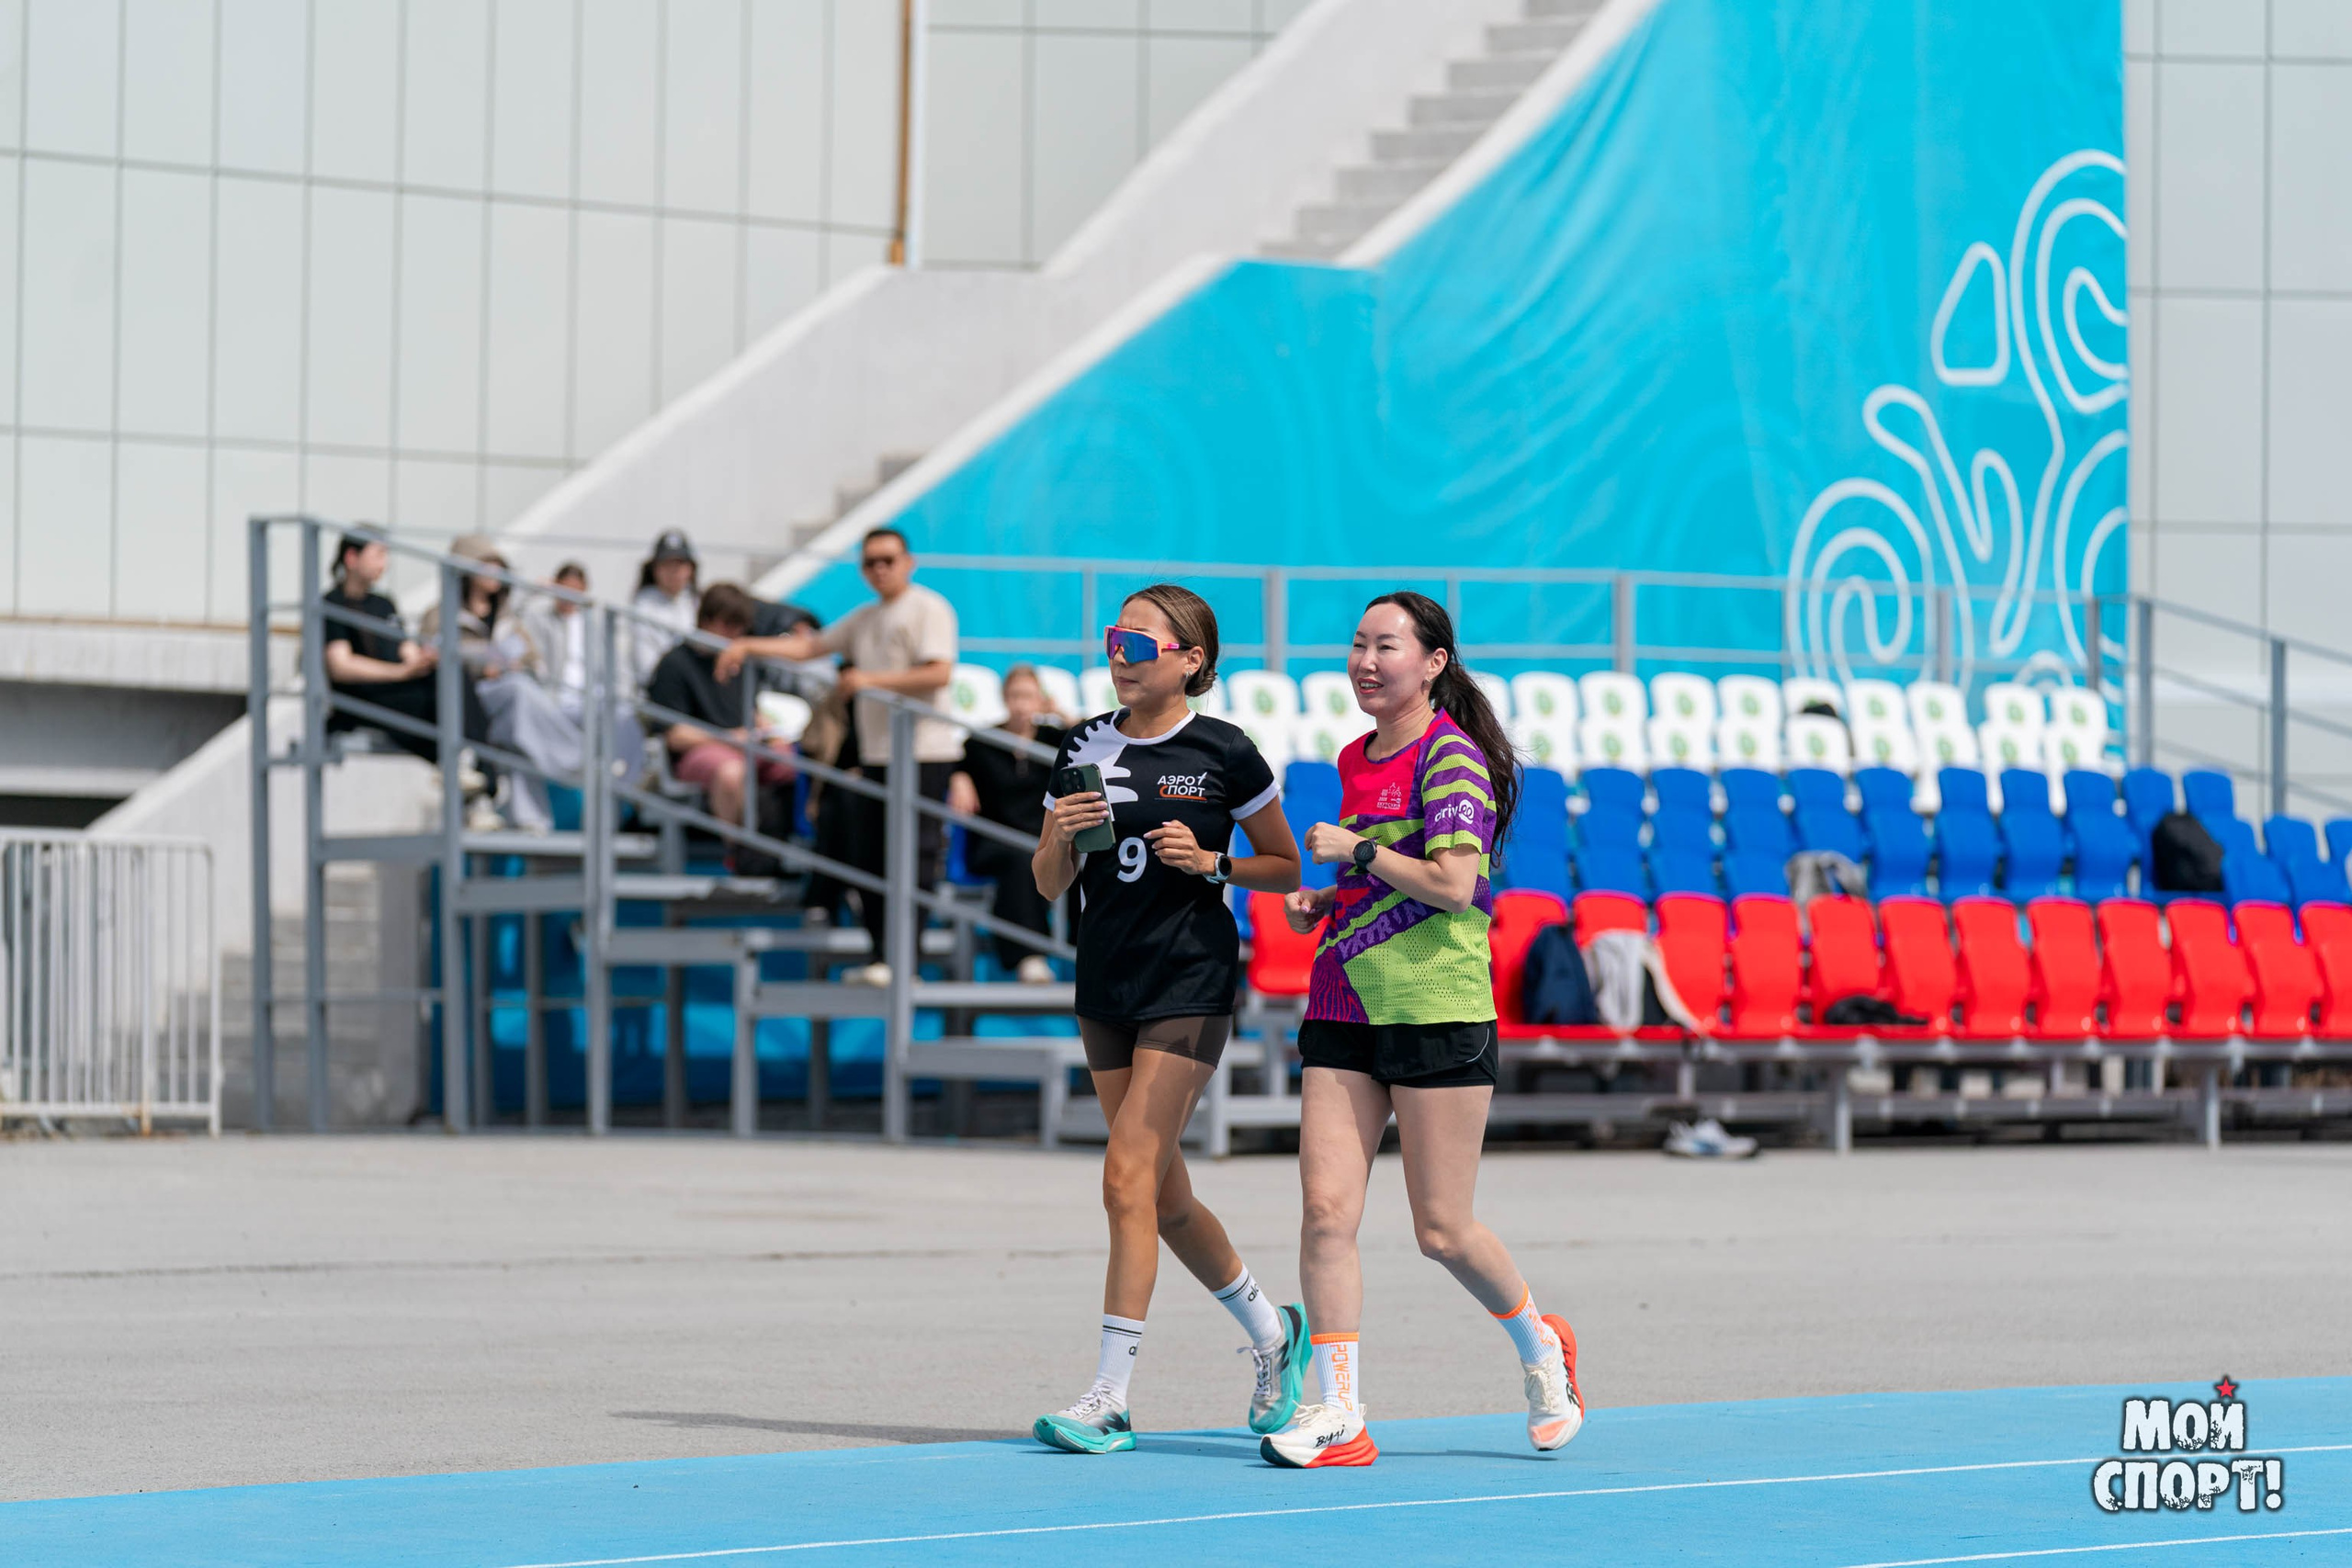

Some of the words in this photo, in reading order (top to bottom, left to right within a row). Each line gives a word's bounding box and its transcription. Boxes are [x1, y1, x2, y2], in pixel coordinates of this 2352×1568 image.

[1157, 774, 1196, 786] АЭРО
[1159, 785, 1206, 799] СПОРТ
[1116, 837, 1148, 883] 9
